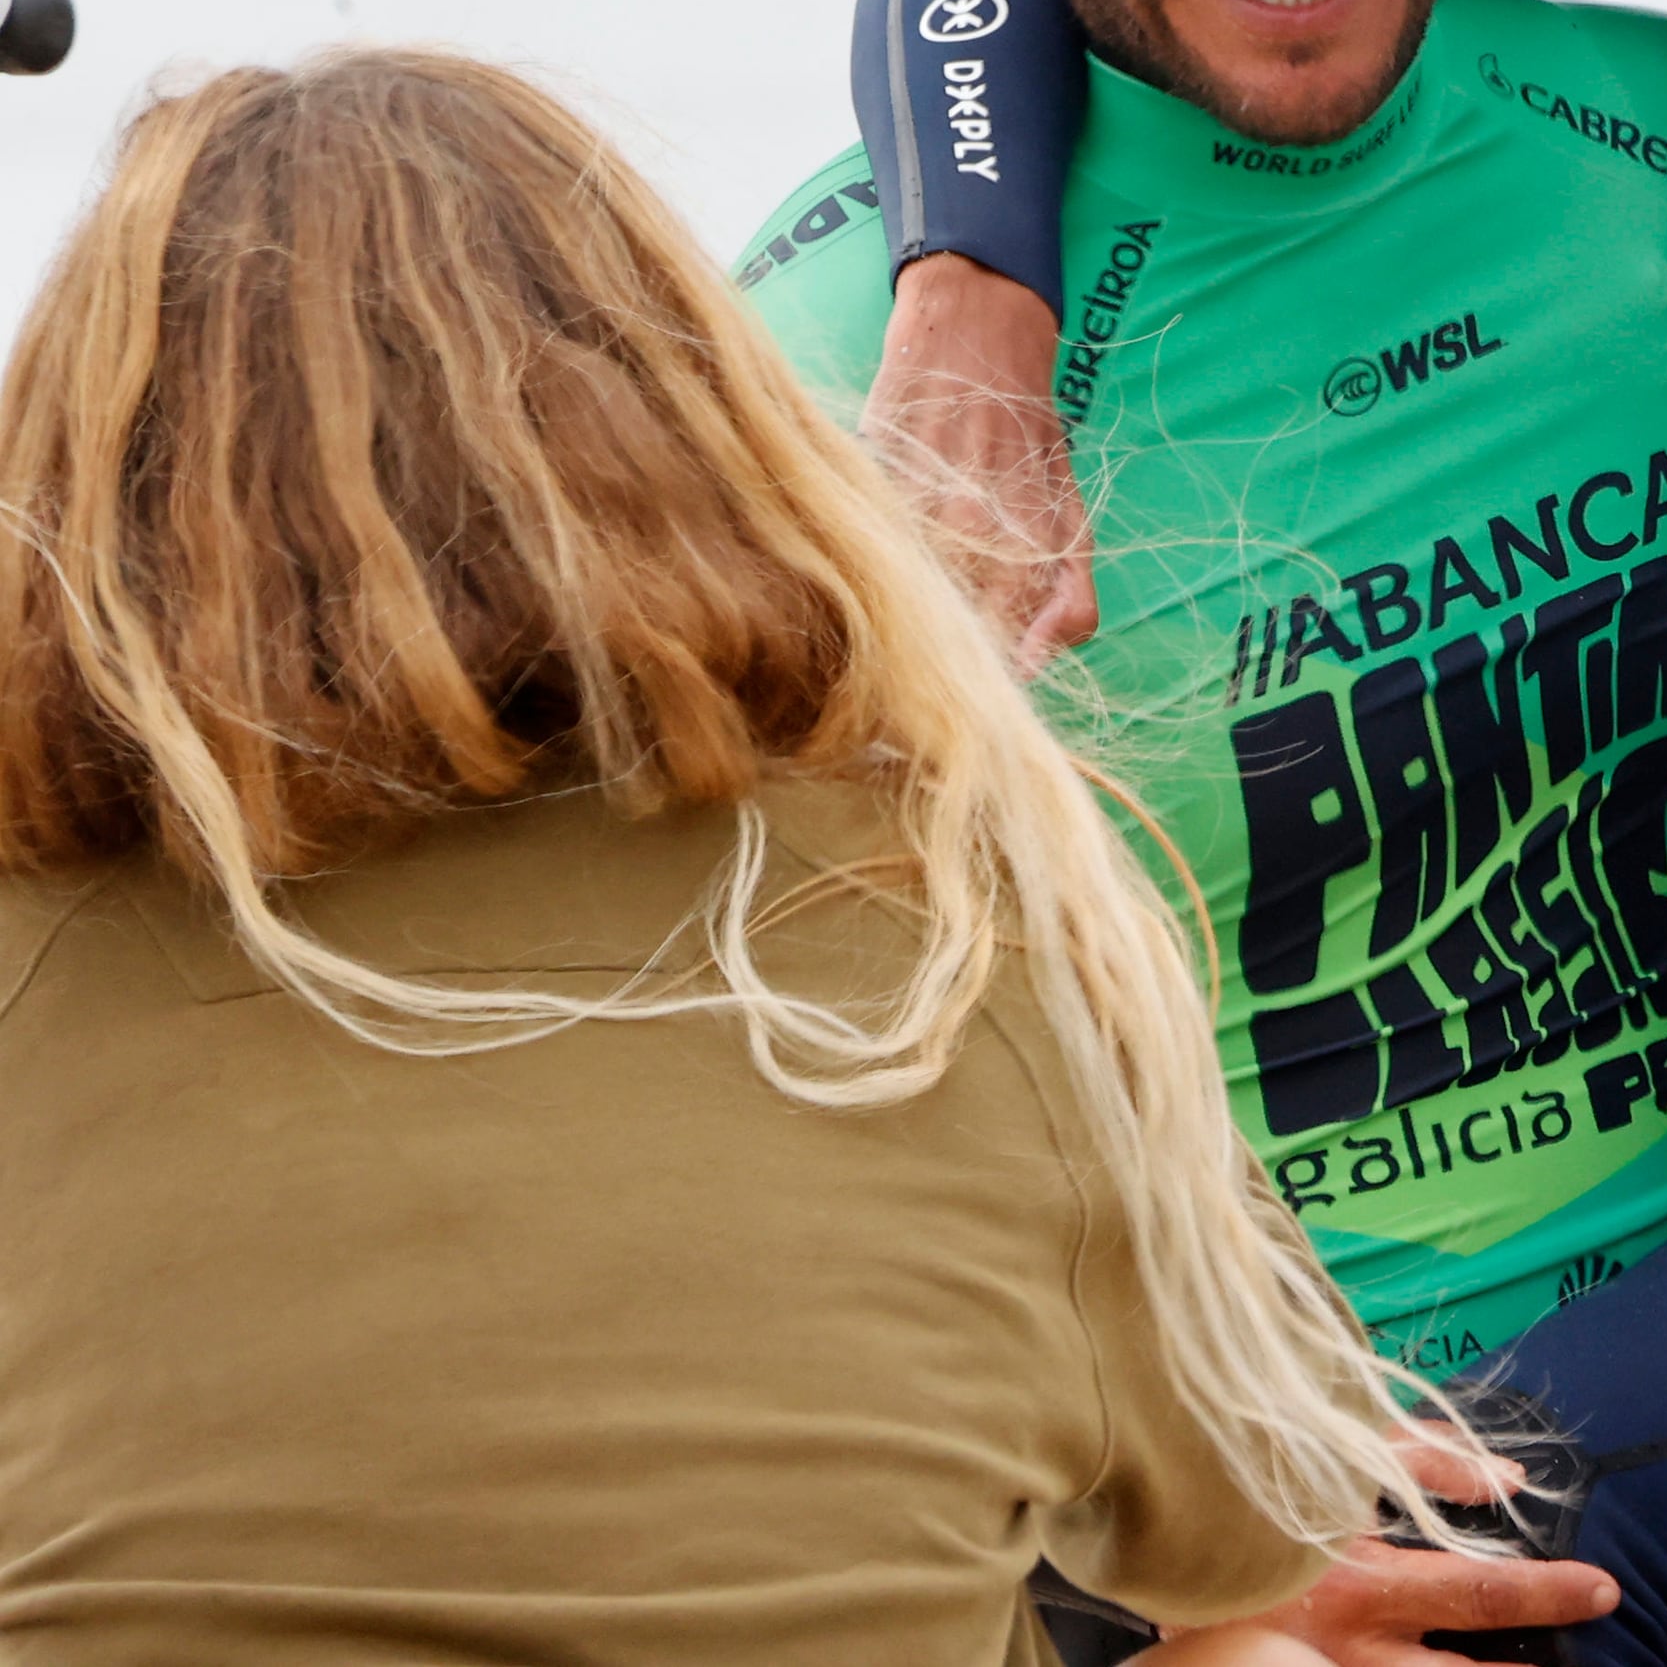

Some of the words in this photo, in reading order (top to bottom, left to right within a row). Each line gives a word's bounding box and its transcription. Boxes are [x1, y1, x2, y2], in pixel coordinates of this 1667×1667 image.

[1212, 140, 1332, 176] WORLD
[734, 178, 880, 292] ADIS
[1380, 312, 1501, 394] WSL
[1275, 1091, 1572, 1211] galicia
